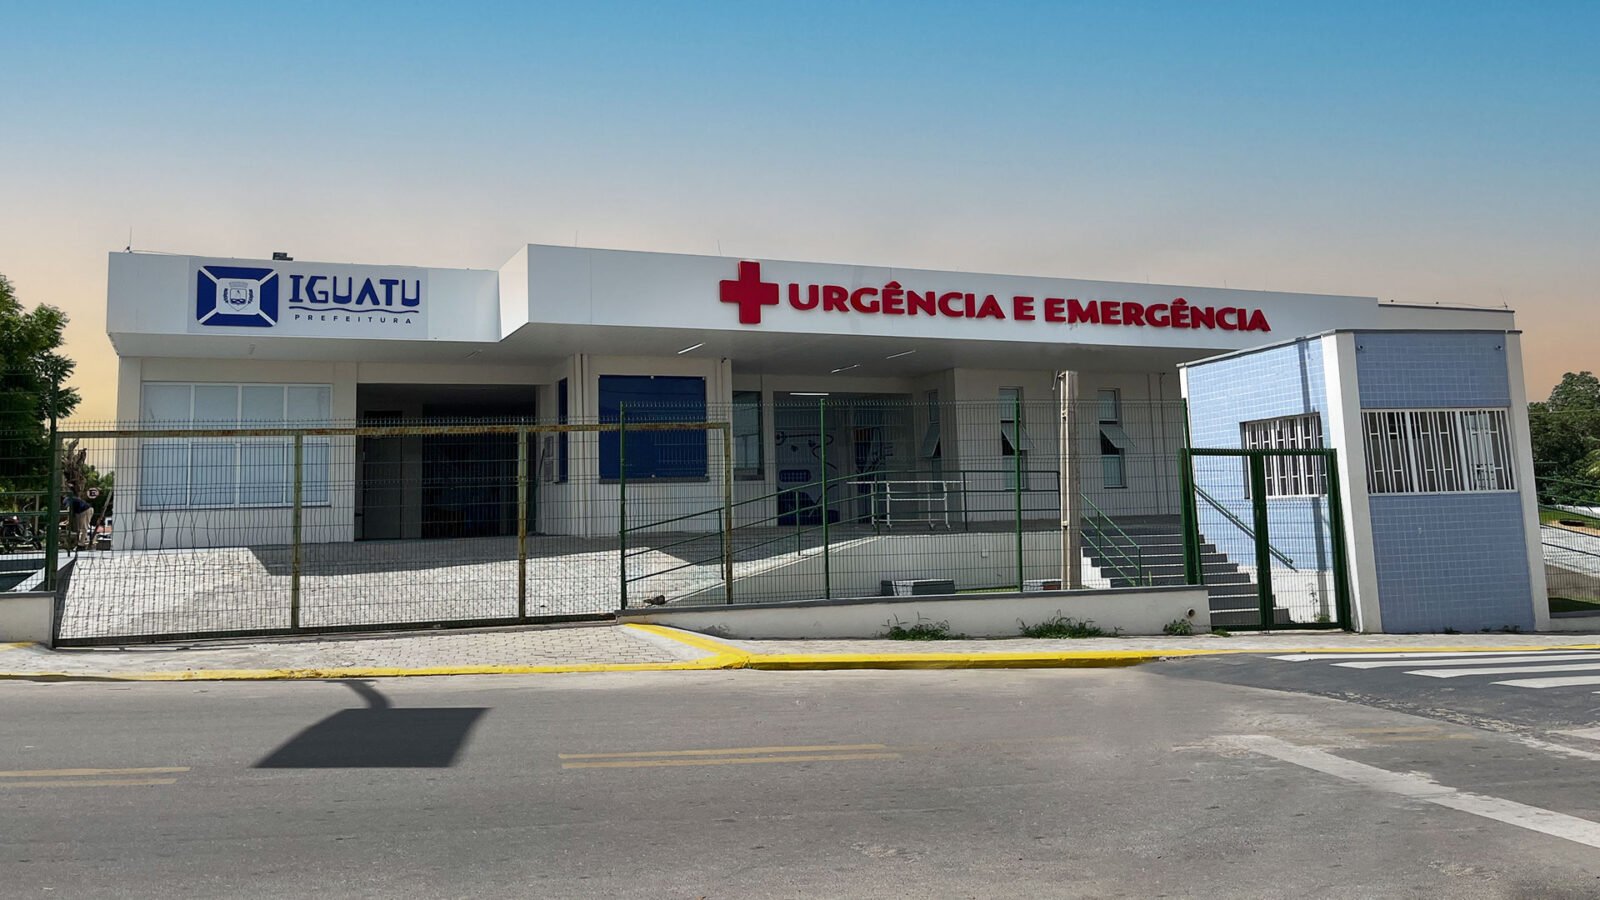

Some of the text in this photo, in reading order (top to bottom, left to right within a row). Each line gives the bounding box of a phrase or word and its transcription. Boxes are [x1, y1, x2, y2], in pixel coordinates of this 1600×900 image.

[289, 274, 420, 307] IGUATU
[788, 281, 1271, 332] URGÊNCIA E EMERGÊNCIA
[294, 314, 412, 324] PREFEITURA
